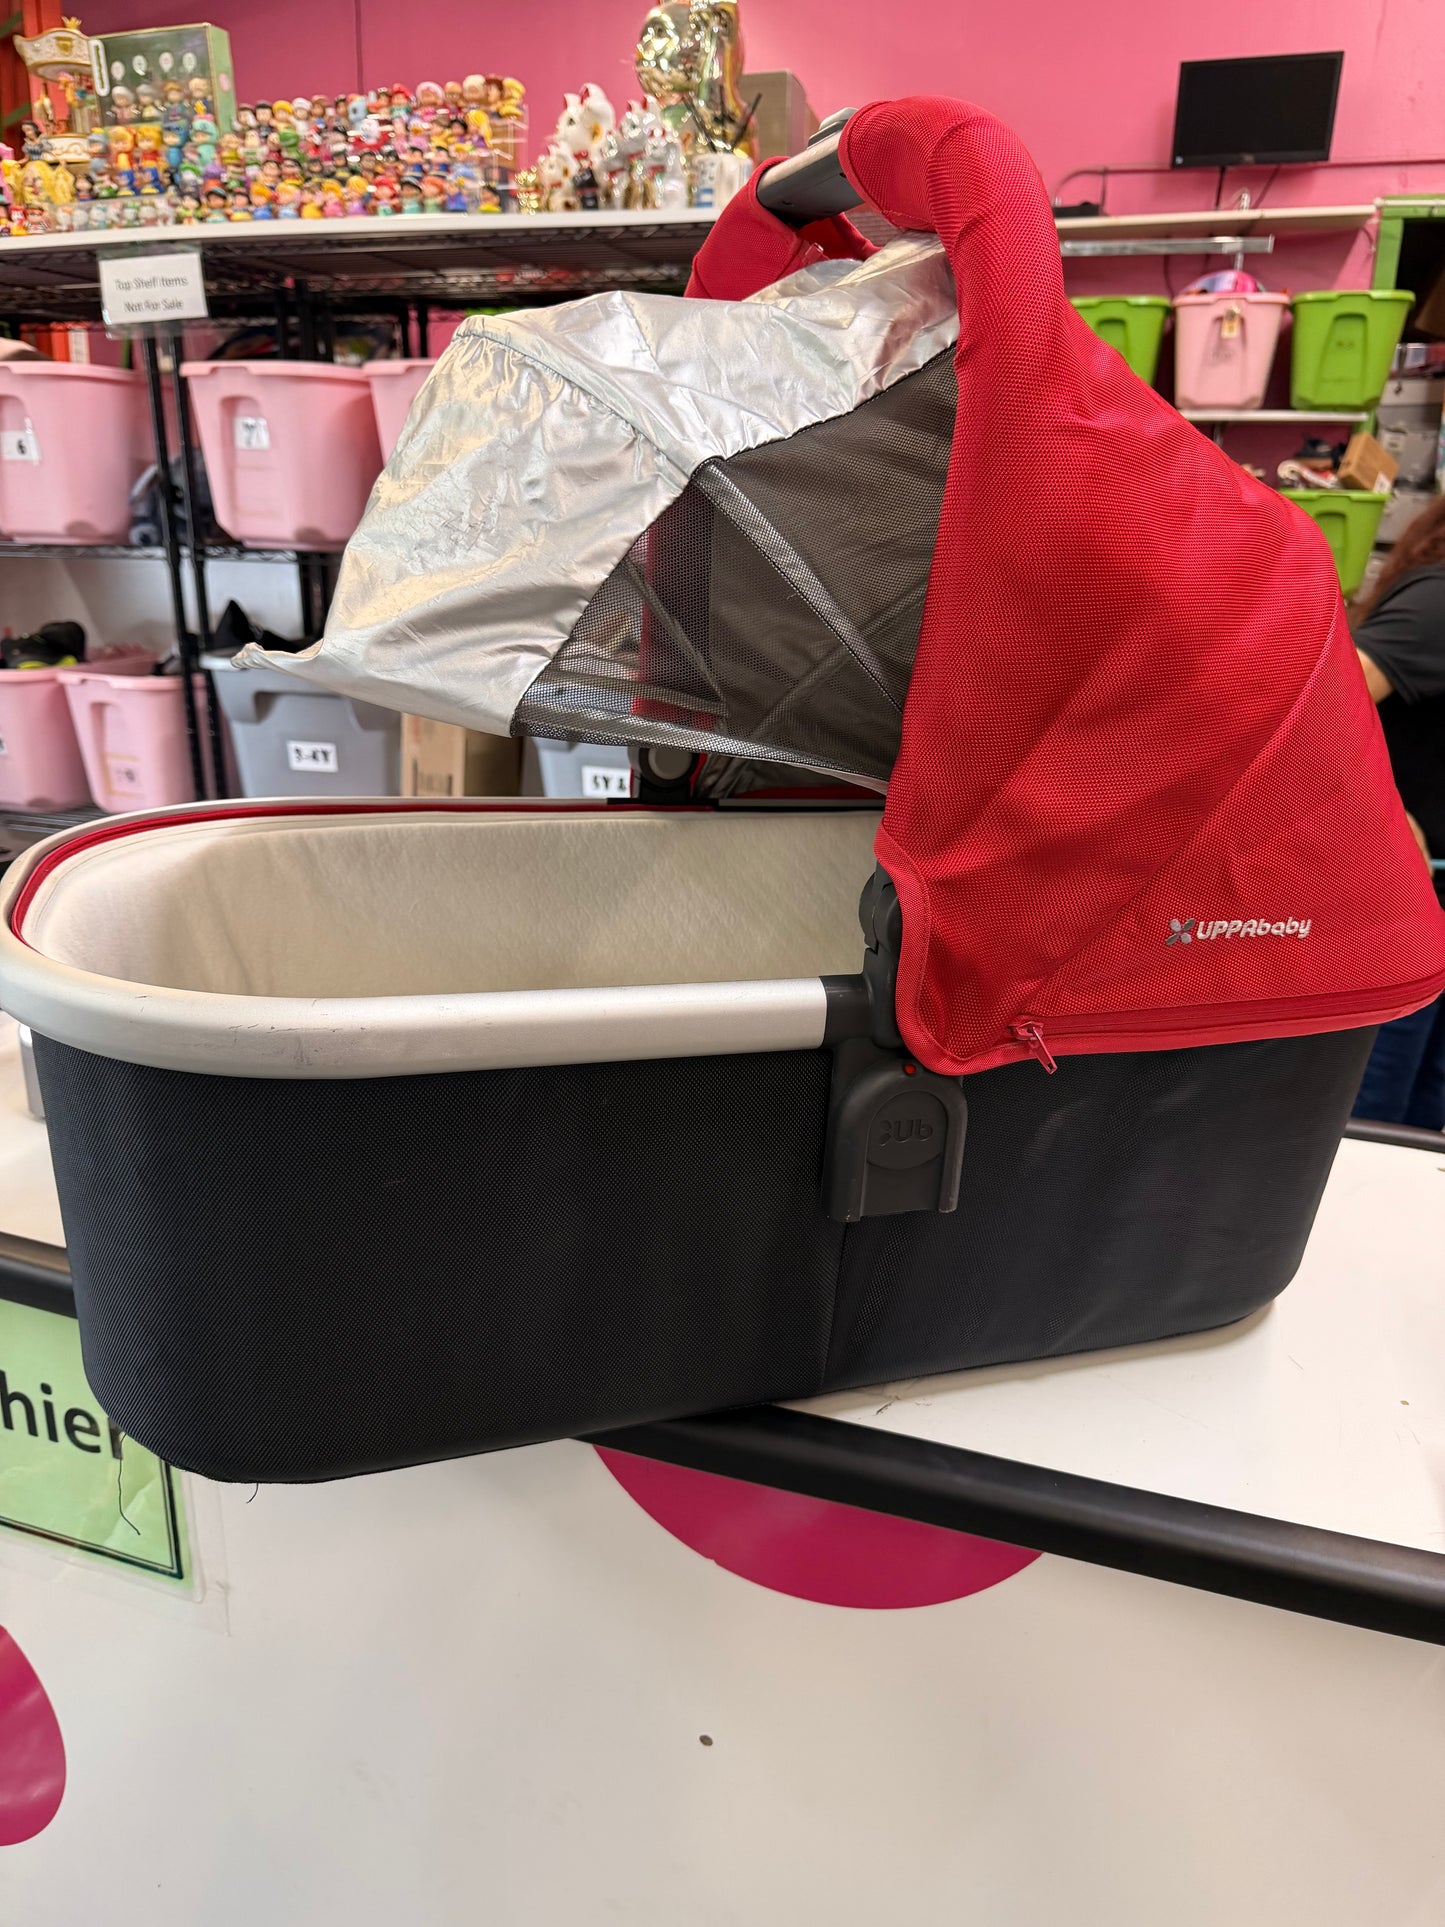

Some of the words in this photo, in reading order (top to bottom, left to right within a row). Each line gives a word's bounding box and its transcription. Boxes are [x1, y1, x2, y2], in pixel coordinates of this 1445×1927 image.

[114, 279, 131, 292] Top
[134, 276, 157, 290] Shelf
[124, 301, 141, 313] Not
[144, 300, 160, 311] For
[162, 298, 184, 311] Sale
[1197, 917, 1311, 940] UPPAbaby
